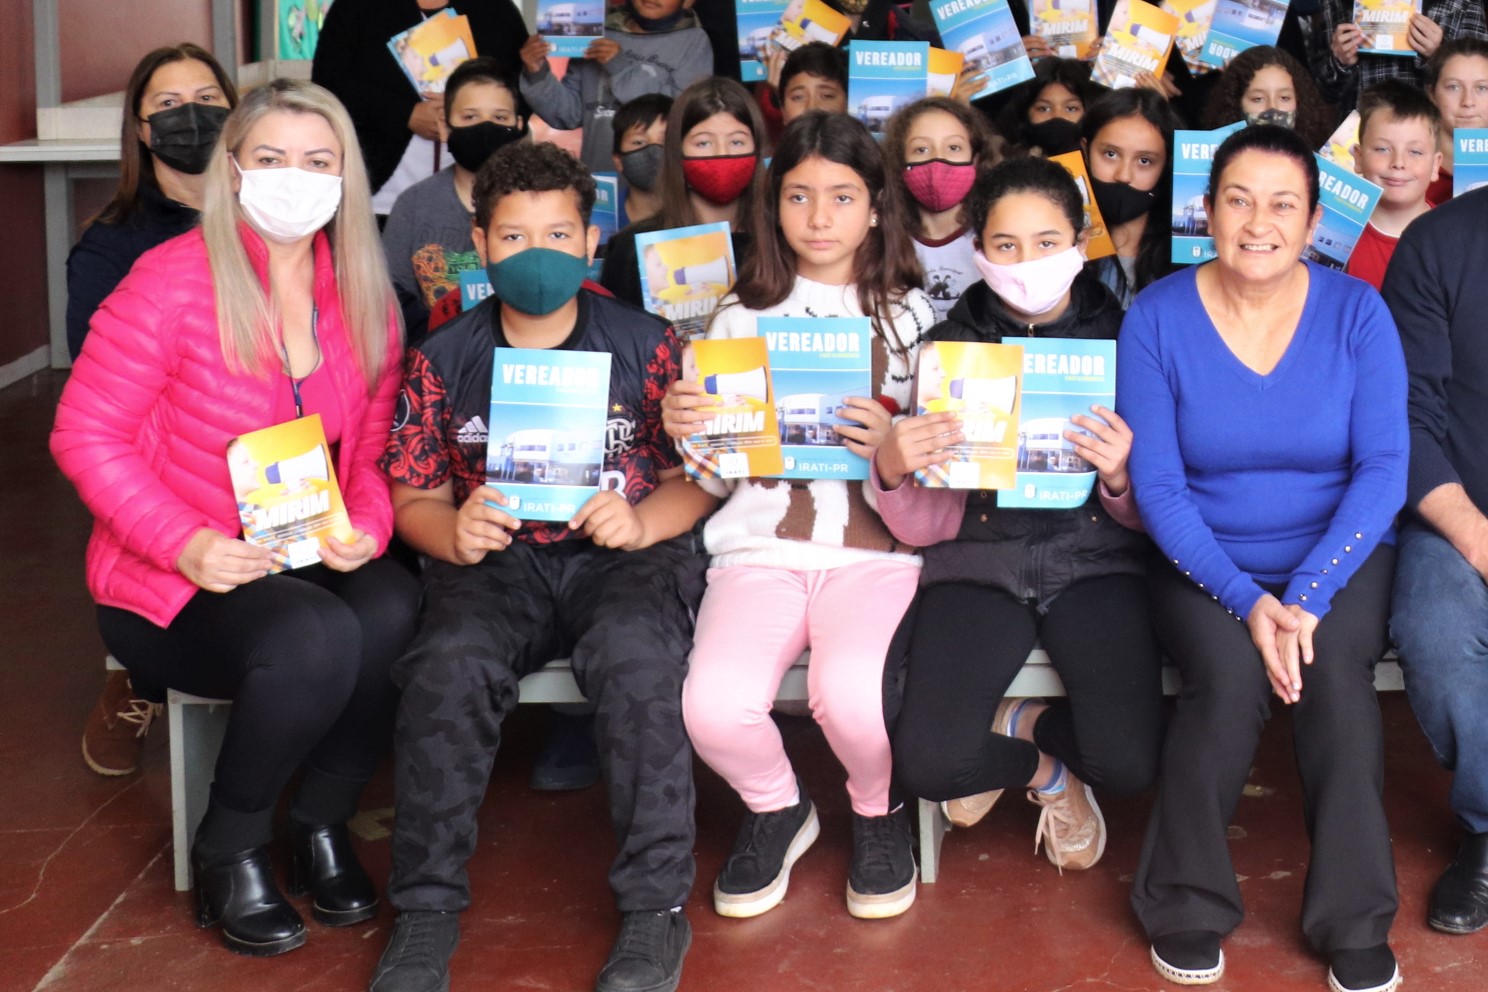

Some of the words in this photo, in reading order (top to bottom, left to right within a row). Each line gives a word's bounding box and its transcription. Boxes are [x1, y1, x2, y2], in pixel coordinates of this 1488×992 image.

[1362, 10, 1409, 23] MIRIM
[1043, 21, 1089, 35] MIRIM
[856, 51, 922, 66] VEREADOR
[1110, 44, 1160, 72] MIRIM
[1318, 172, 1370, 209] READOR
[765, 332, 860, 353] VEREADOR
[1024, 352, 1105, 374] EREADOR
[502, 363, 599, 389] VEREADOR
[457, 433, 489, 443] adida
[799, 463, 849, 473] IRATI-PR
[1040, 489, 1088, 501] IRATI-PR
[255, 489, 330, 531] MIRIM
[523, 502, 577, 514] IRATI-PR
